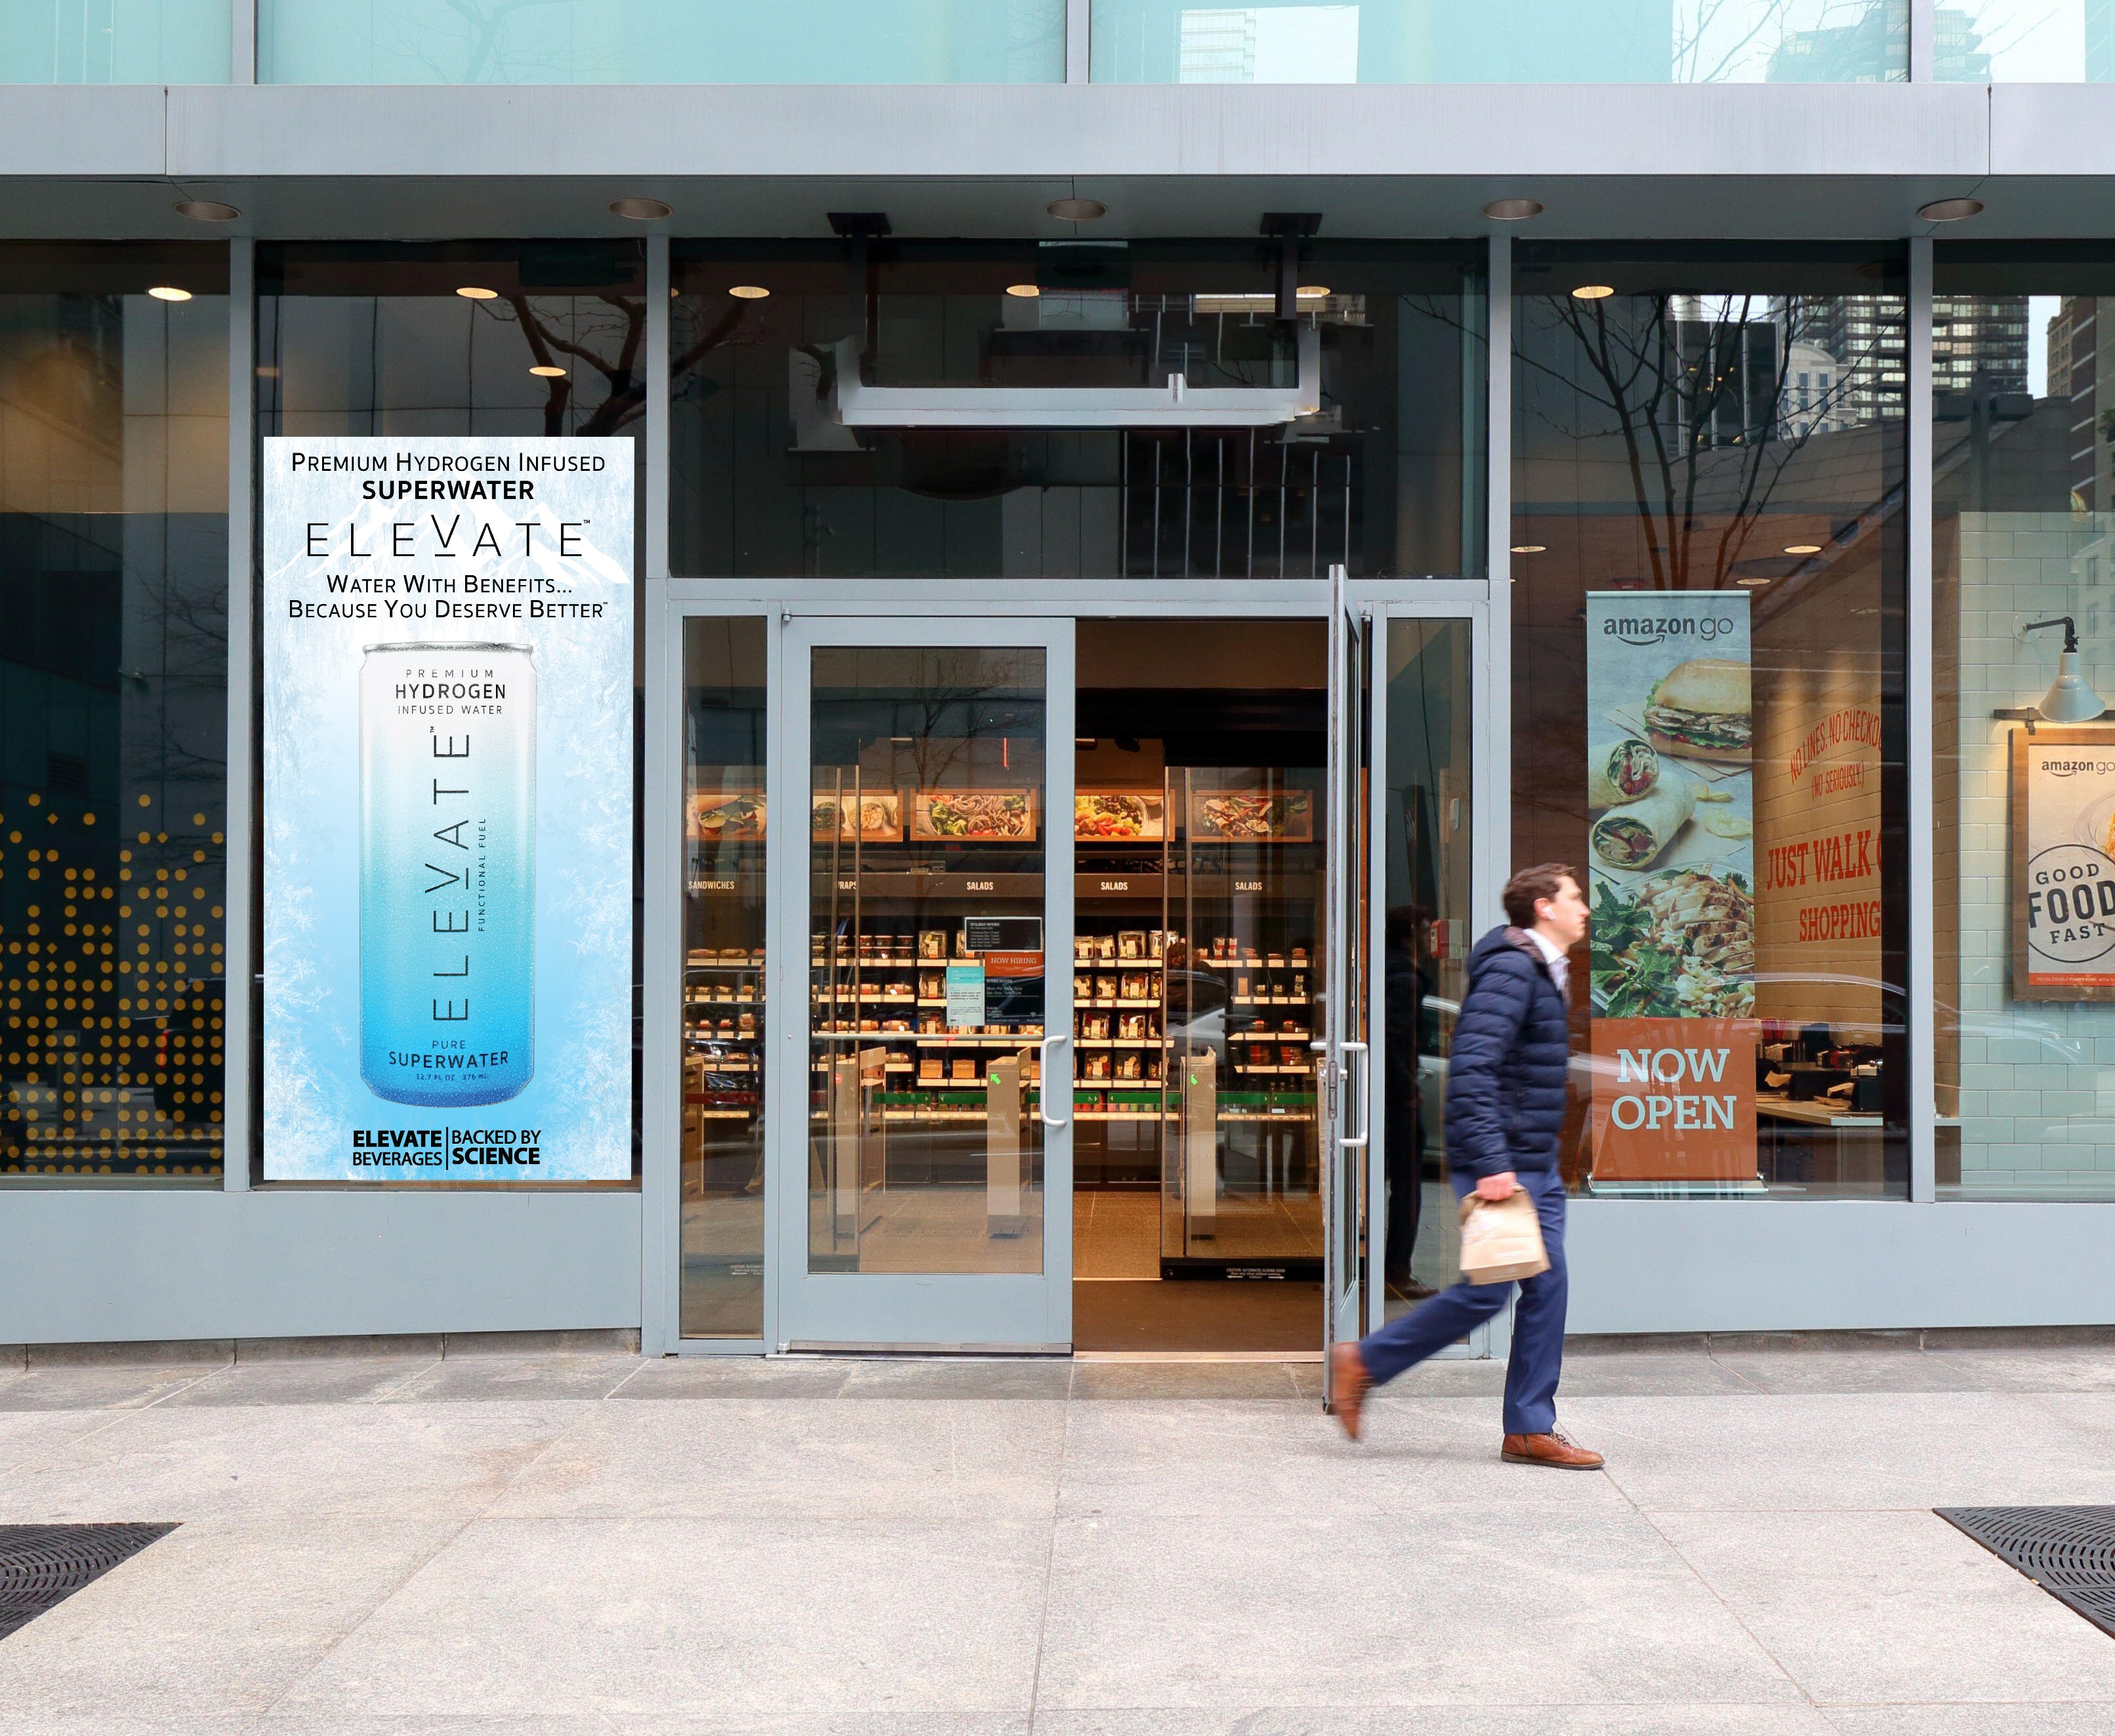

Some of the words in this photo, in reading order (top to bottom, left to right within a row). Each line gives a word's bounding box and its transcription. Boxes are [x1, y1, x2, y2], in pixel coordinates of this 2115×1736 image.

[292, 453, 387, 472] PREMIUM
[396, 453, 510, 472] HYDROGEN
[520, 453, 605, 472] INFUSED
[362, 480, 534, 500] SUPERWATER
[327, 575, 396, 593] WATER
[403, 575, 455, 593] WITH
[289, 599, 377, 618] BECAUSE
[384, 599, 426, 618] YOU
[436, 599, 522, 618] DESERVE
[1604, 618, 1694, 638] amazon
[1700, 618, 1733, 641] go
[406, 669, 493, 678] PREMIUM
[396, 684, 505, 699] HYDROGEN
[398, 705, 453, 714] INFUSED
[461, 705, 502, 714] WATER
[1790, 748, 1801, 785] NO
[1803, 722, 1828, 768] LINES.
[1829, 713, 1841, 746] NO
[2042, 761, 2094, 774] amazon
[2096, 761, 2115, 775] go
[1812, 773, 1823, 801] (NO
[1767, 842, 1808, 890] JUST
[1813, 830, 1871, 882] WALK
[2036, 863, 2099, 885] GOOD
[688, 881, 735, 890] SANDWICHES
[838, 881, 857, 890] RAPS
[966, 881, 994, 891] SALADS
[1100, 881, 1128, 891] SALADS
[1235, 881, 1262, 891] SALADS
[2028, 880, 2115, 928] FOOD
[1799, 900, 1881, 941] SHOPPING
[2050, 923, 2105, 944] FAST
[432, 1040, 466, 1049] PURE
[388, 1051, 508, 1069] SUPERWATER
[1617, 1048, 1730, 1083] NOW
[1611, 1095, 1737, 1130] OPEN
[353, 1130, 442, 1148] ELEVATE
[452, 1129, 517, 1144] BACKED
[521, 1129, 542, 1144] BY
[352, 1151, 443, 1166] BEVERAGES
[451, 1147, 541, 1165] SCIENCE
